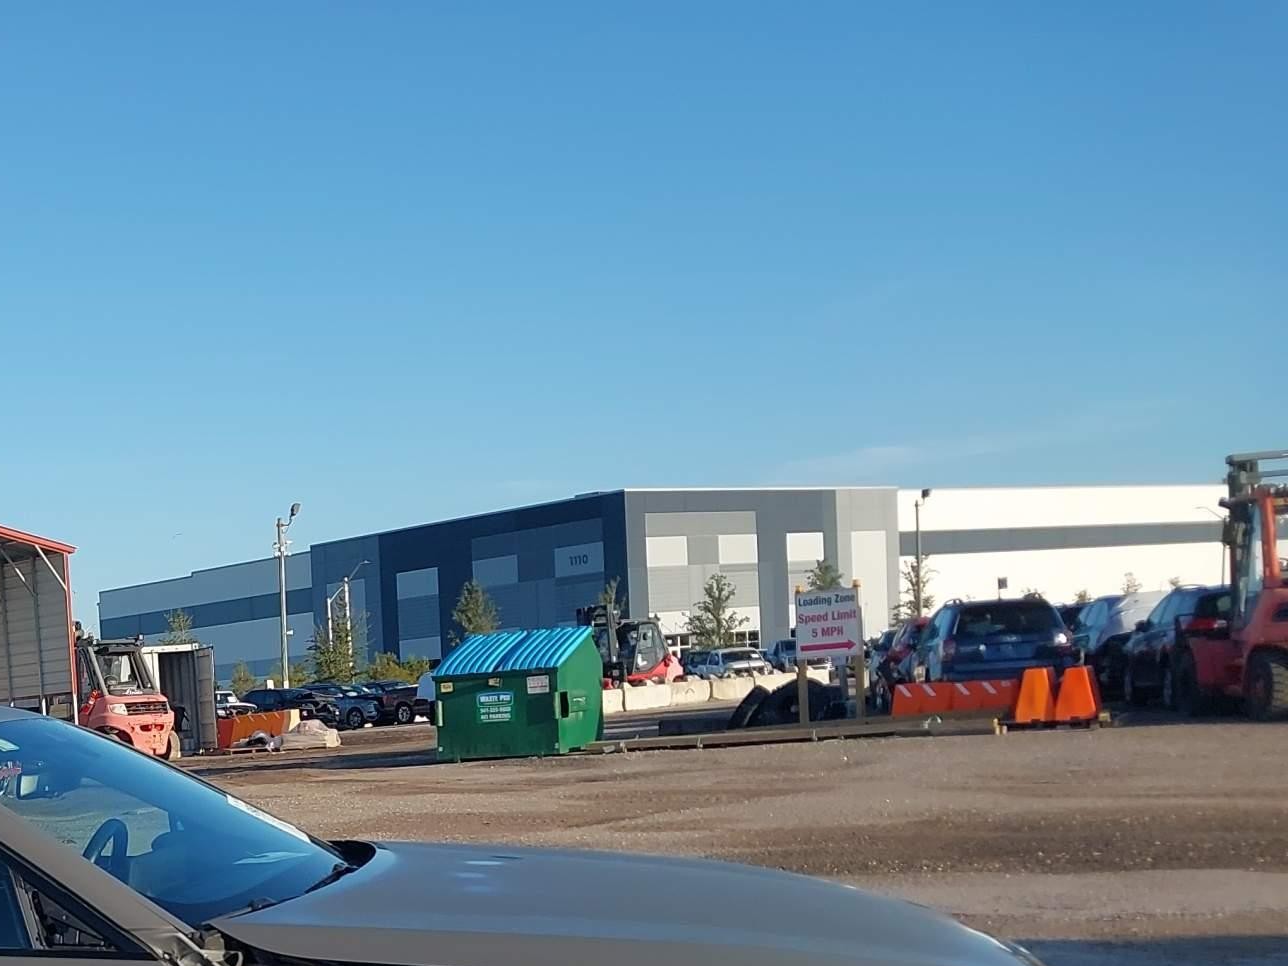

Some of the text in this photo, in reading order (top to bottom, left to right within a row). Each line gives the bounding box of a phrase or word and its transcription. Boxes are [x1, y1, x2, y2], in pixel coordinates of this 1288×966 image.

[569, 554, 589, 566] 1110
[798, 594, 856, 607] Loading Zone
[798, 609, 857, 625] Speed Limit
[812, 627, 844, 638] 5 MPH
